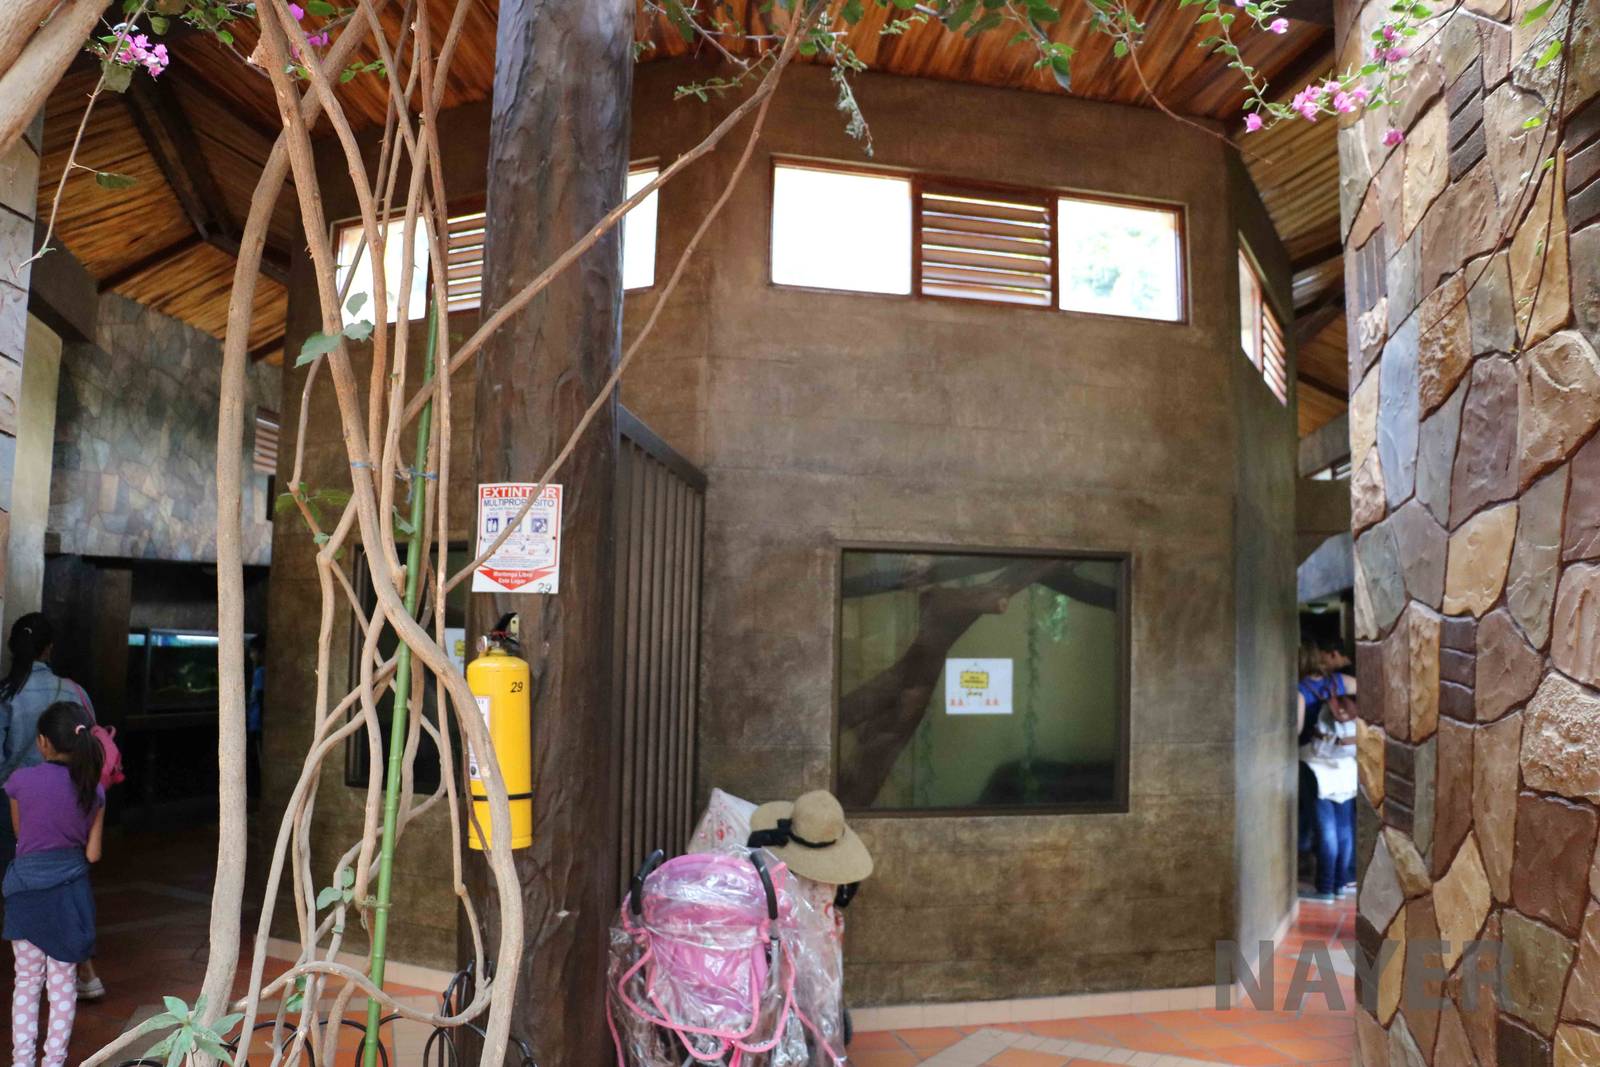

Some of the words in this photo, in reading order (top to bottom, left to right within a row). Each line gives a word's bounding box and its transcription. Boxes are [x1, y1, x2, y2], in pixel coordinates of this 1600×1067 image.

[484, 499, 554, 507] MULTIPROPSITO
[537, 583, 552, 593] 29
[510, 681, 523, 693] 29
